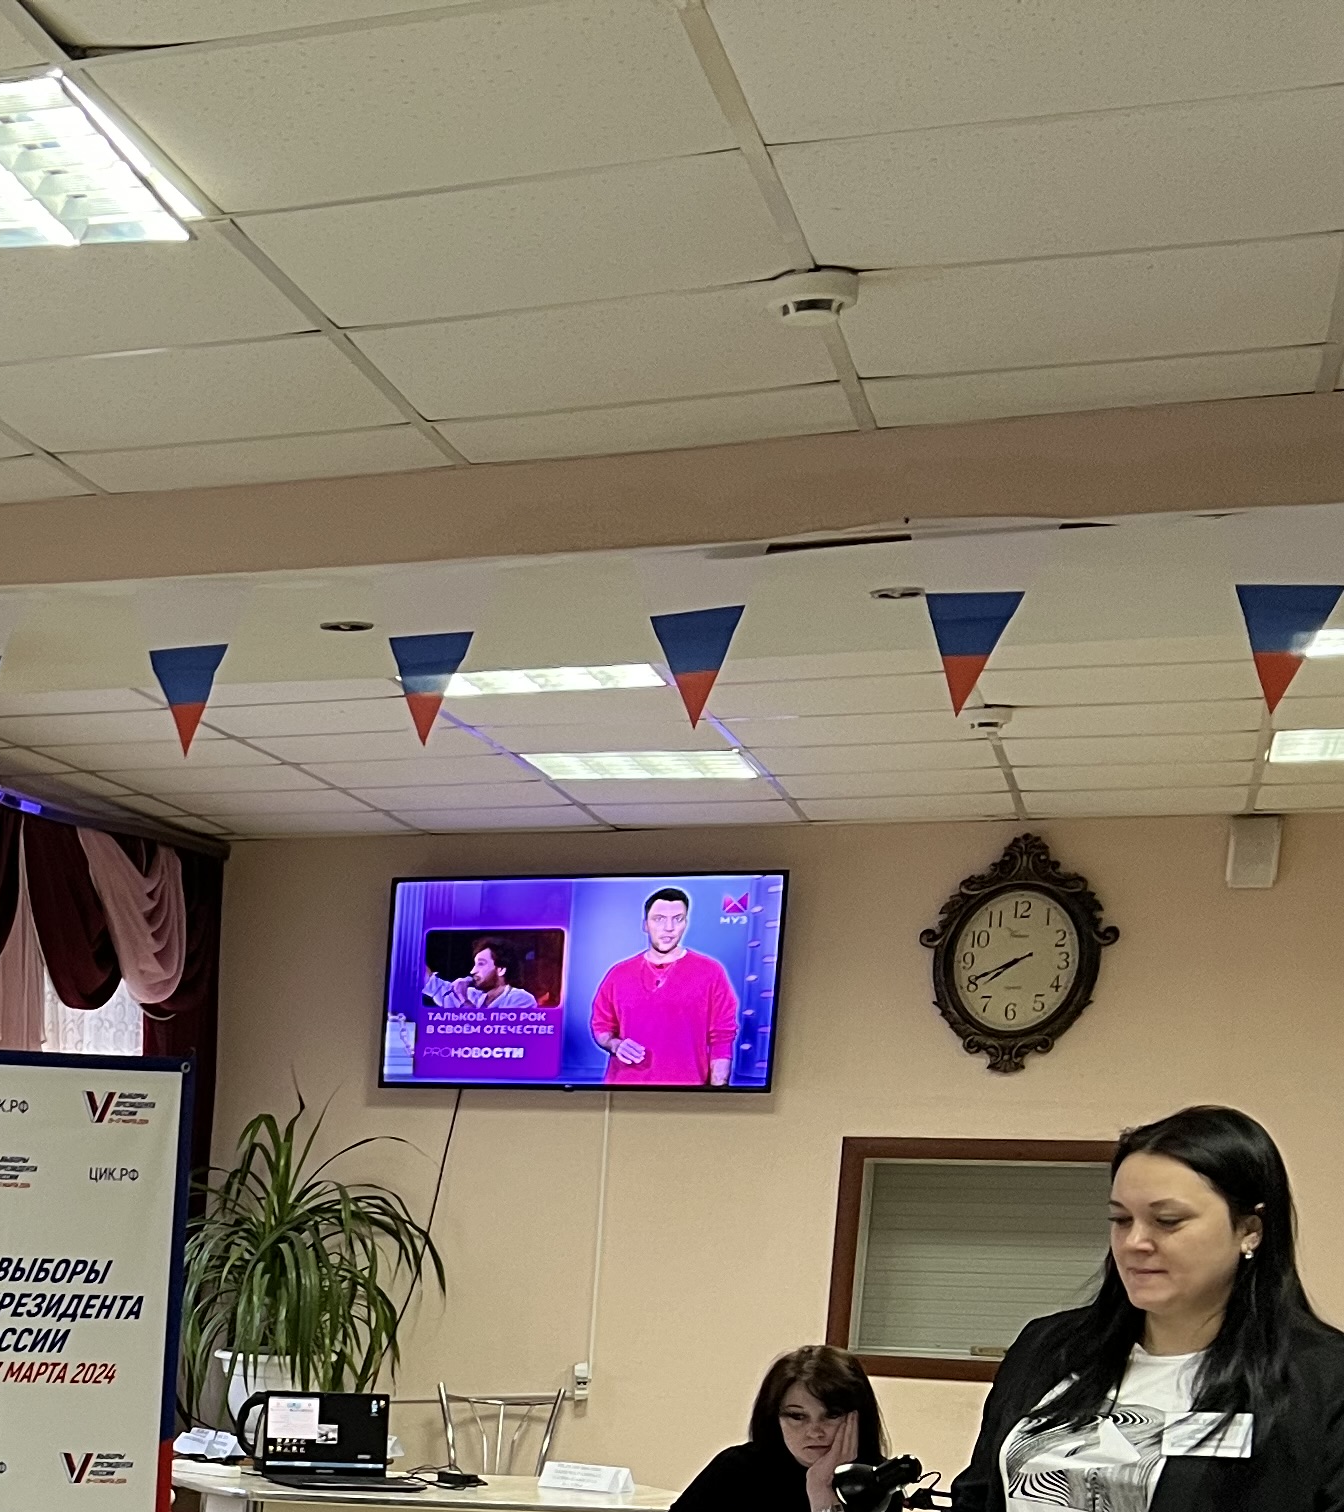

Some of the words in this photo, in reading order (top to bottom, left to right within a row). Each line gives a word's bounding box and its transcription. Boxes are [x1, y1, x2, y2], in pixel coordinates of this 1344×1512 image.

[720, 915, 748, 925] МУЗ
[427, 1012, 487, 1021] ТАЛЬКОВ.
[490, 1012, 517, 1021] ПРО
[520, 1012, 547, 1021] РОК
[426, 1025, 434, 1034] В
[483, 1024, 554, 1035] ОТЕЧЕСТВЕ
[89, 1166, 139, 1182] ЦИК.РФ
[2, 1361, 68, 1384] МАРТА
[69, 1362, 117, 1384] 2024
